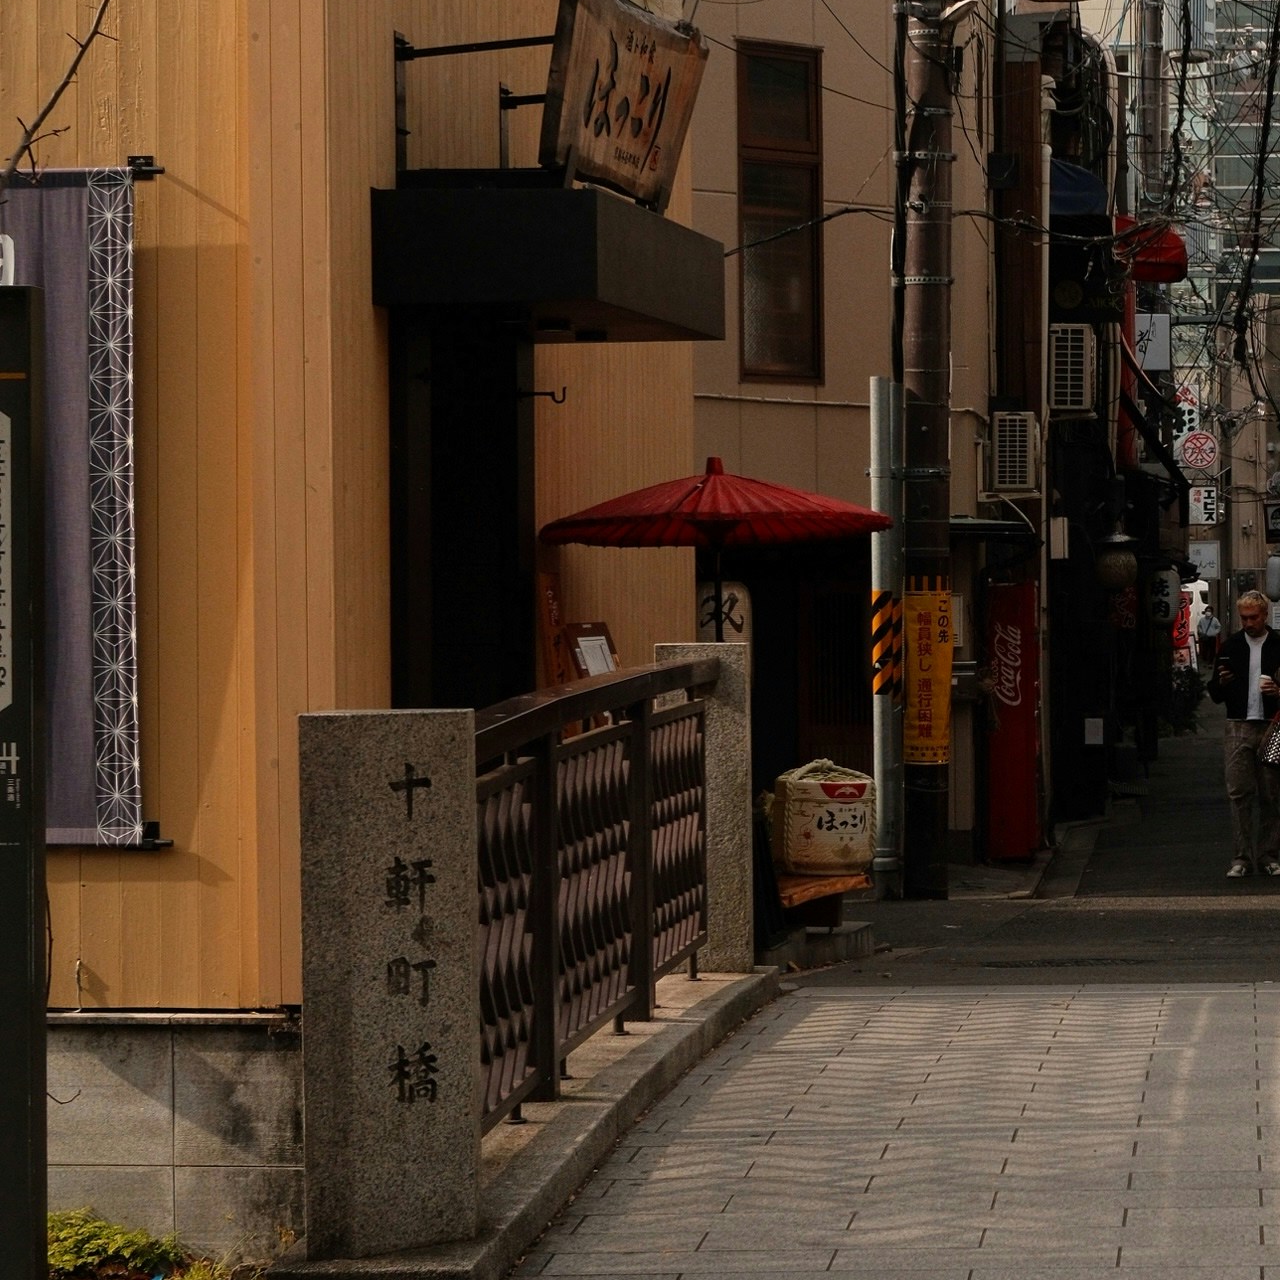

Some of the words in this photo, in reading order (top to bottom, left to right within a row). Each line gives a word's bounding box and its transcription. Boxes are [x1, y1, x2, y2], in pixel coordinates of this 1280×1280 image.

[1203, 489, 1215, 522] エビス
[937, 599, 949, 644] この先
[1151, 578, 1170, 619] 焼肉
[917, 611, 932, 672] 幅員狭し
[994, 621, 1022, 706] Coca-Cola
[917, 678, 932, 738] 通行困難
[816, 810, 867, 834] ほっこり
[384, 762, 439, 1104] 十軒町橋
